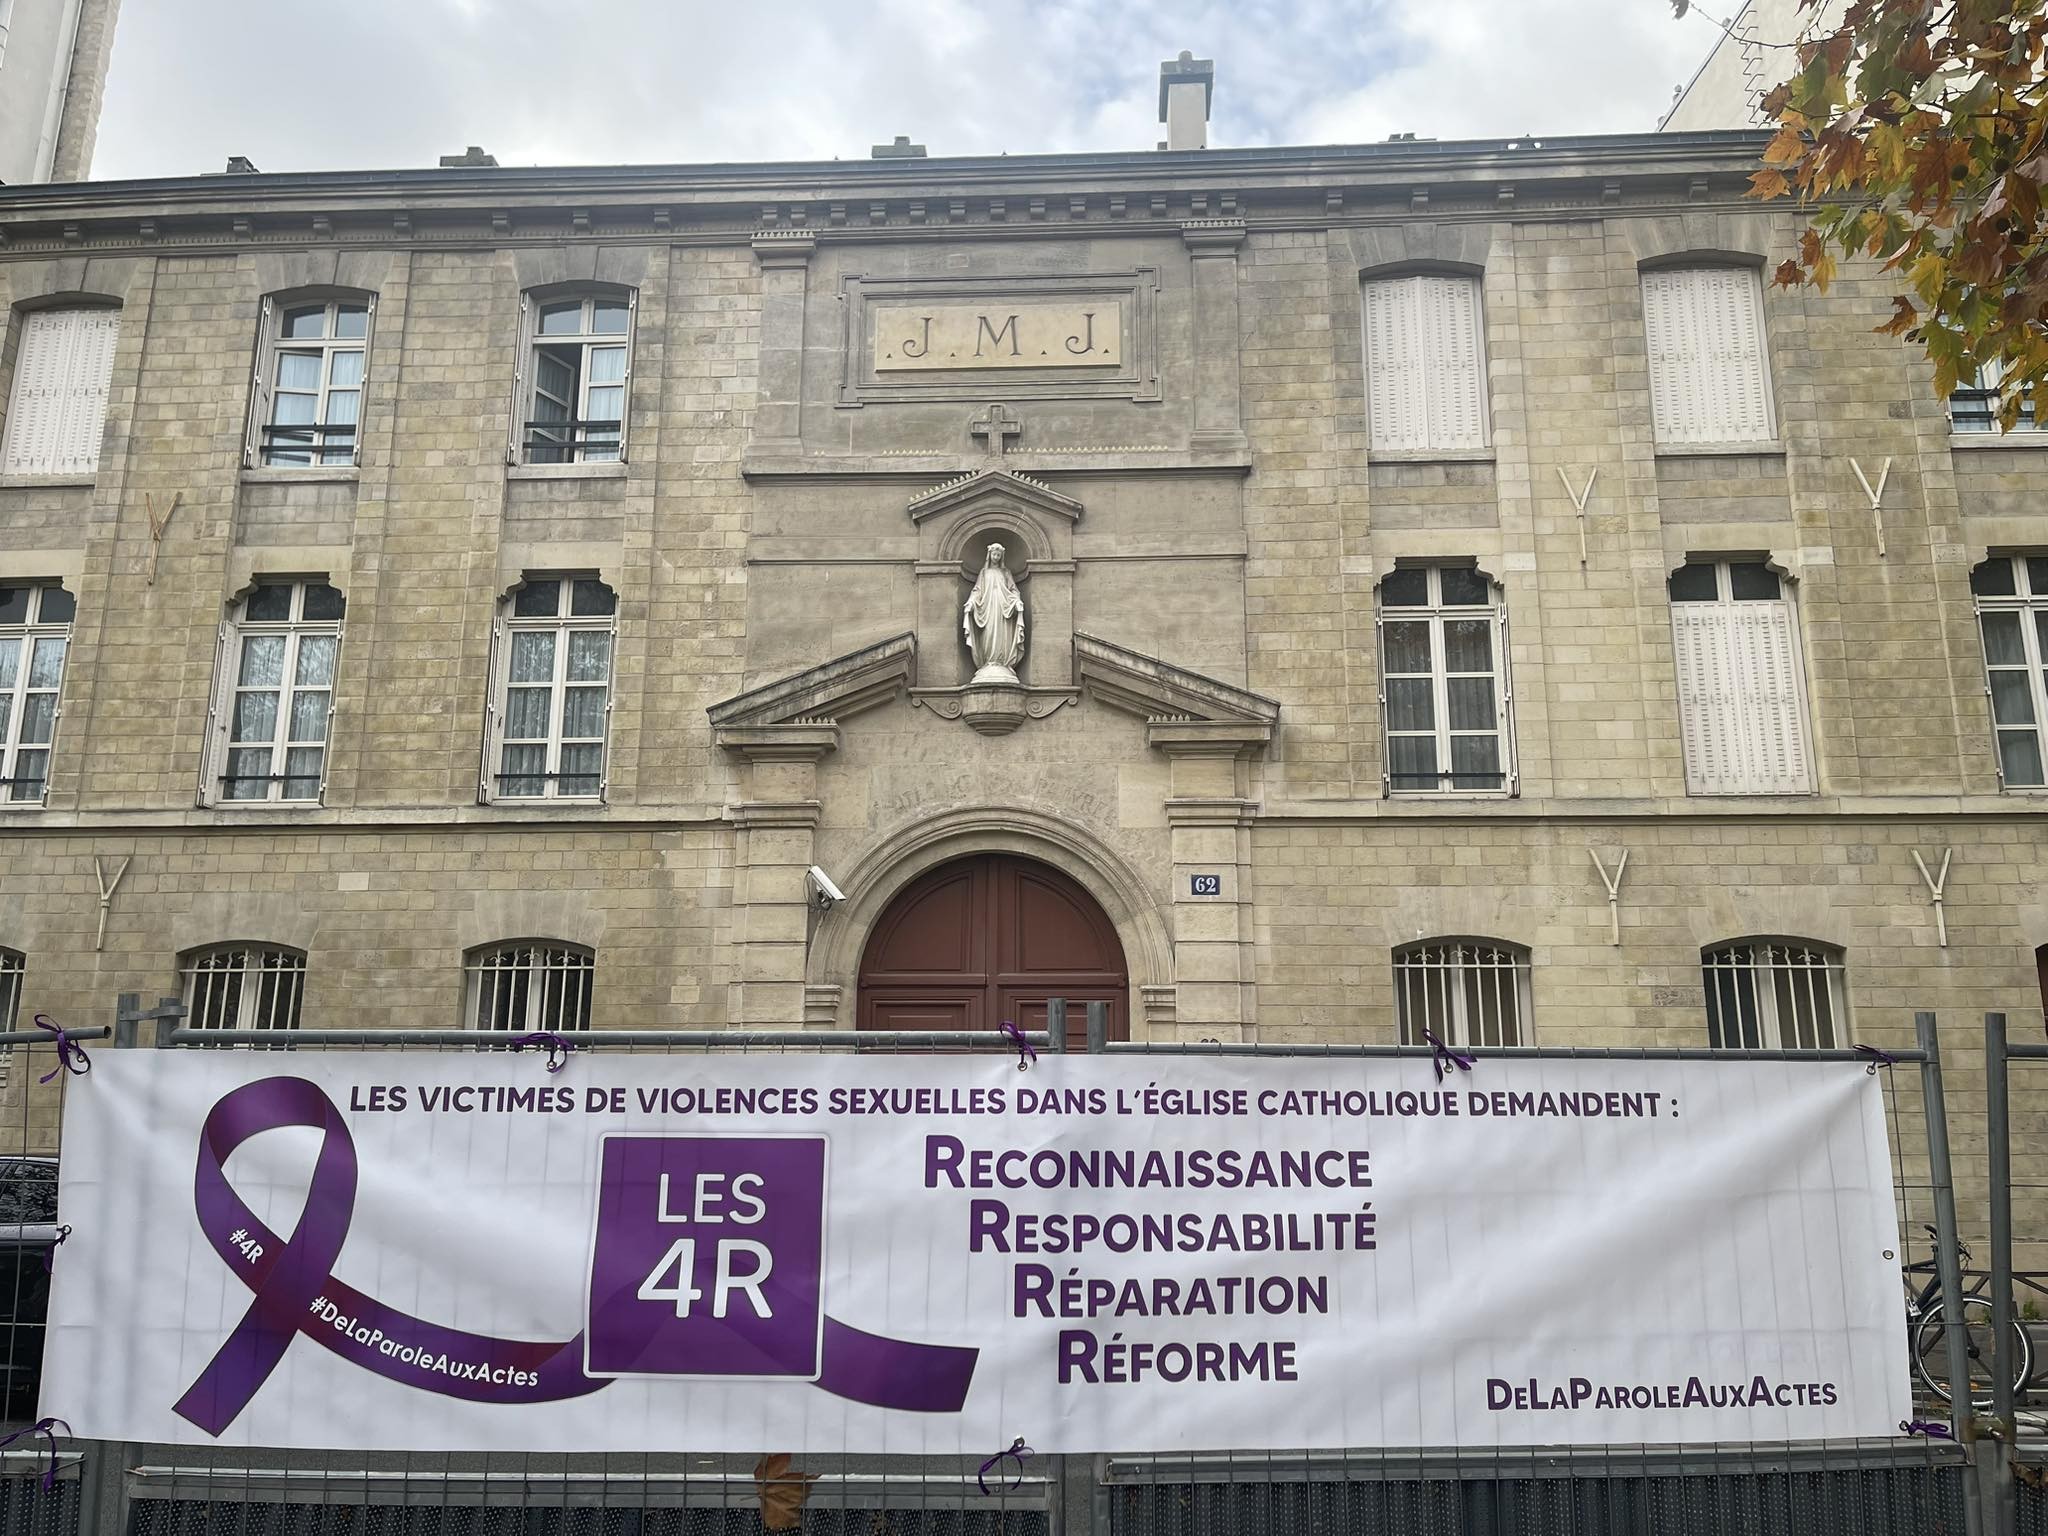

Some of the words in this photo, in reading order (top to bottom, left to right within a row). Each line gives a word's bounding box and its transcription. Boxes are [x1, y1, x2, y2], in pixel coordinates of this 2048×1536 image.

[1195, 877, 1217, 893] 62
[350, 1086, 407, 1112] LES
[419, 1087, 575, 1113] VICTIMES
[586, 1088, 626, 1113] DE
[637, 1088, 819, 1115] VIOLENCES
[829, 1088, 1006, 1115] SEXUELLES
[1017, 1089, 1107, 1115] DANS
[1117, 1082, 1248, 1116] L'ÉGLISE
[1258, 1089, 1459, 1118] CATHOLIQUE
[1469, 1091, 1661, 1117] DEMANDENT
[1671, 1097, 1680, 1118] :
[657, 1173, 767, 1225] LES
[229, 1227, 265, 1265] #4R
[637, 1238, 774, 1319] 4R
[308, 1295, 540, 1389] #DeLaParoleAuxActes
